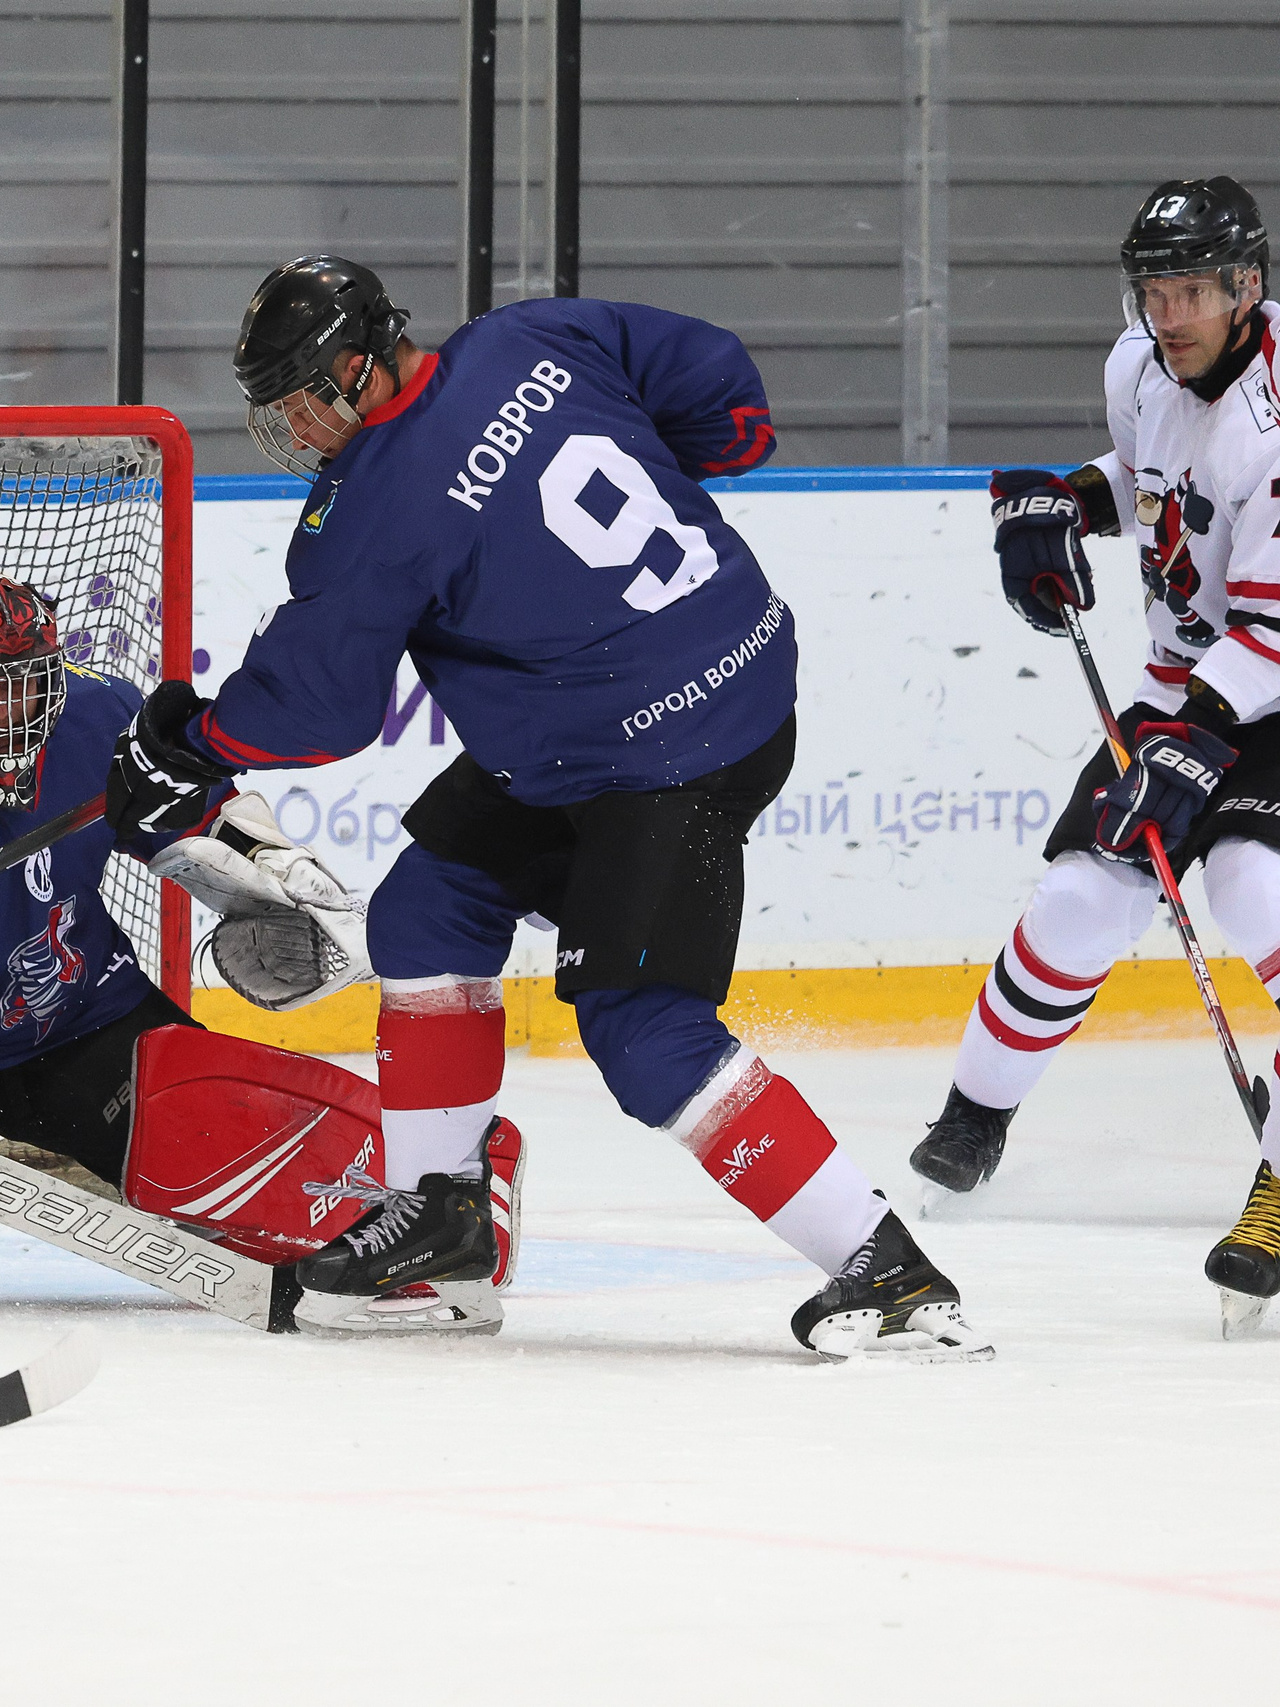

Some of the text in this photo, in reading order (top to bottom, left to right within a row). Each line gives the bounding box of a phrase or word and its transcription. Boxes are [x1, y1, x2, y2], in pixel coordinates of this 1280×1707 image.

[1146, 195, 1187, 219] 13
[447, 359, 573, 512] КОВРОВ
[538, 434, 720, 614] 9
[622, 594, 783, 738] ГОРОД ВОИНСКОЙ
[874, 788, 1050, 846] центр
